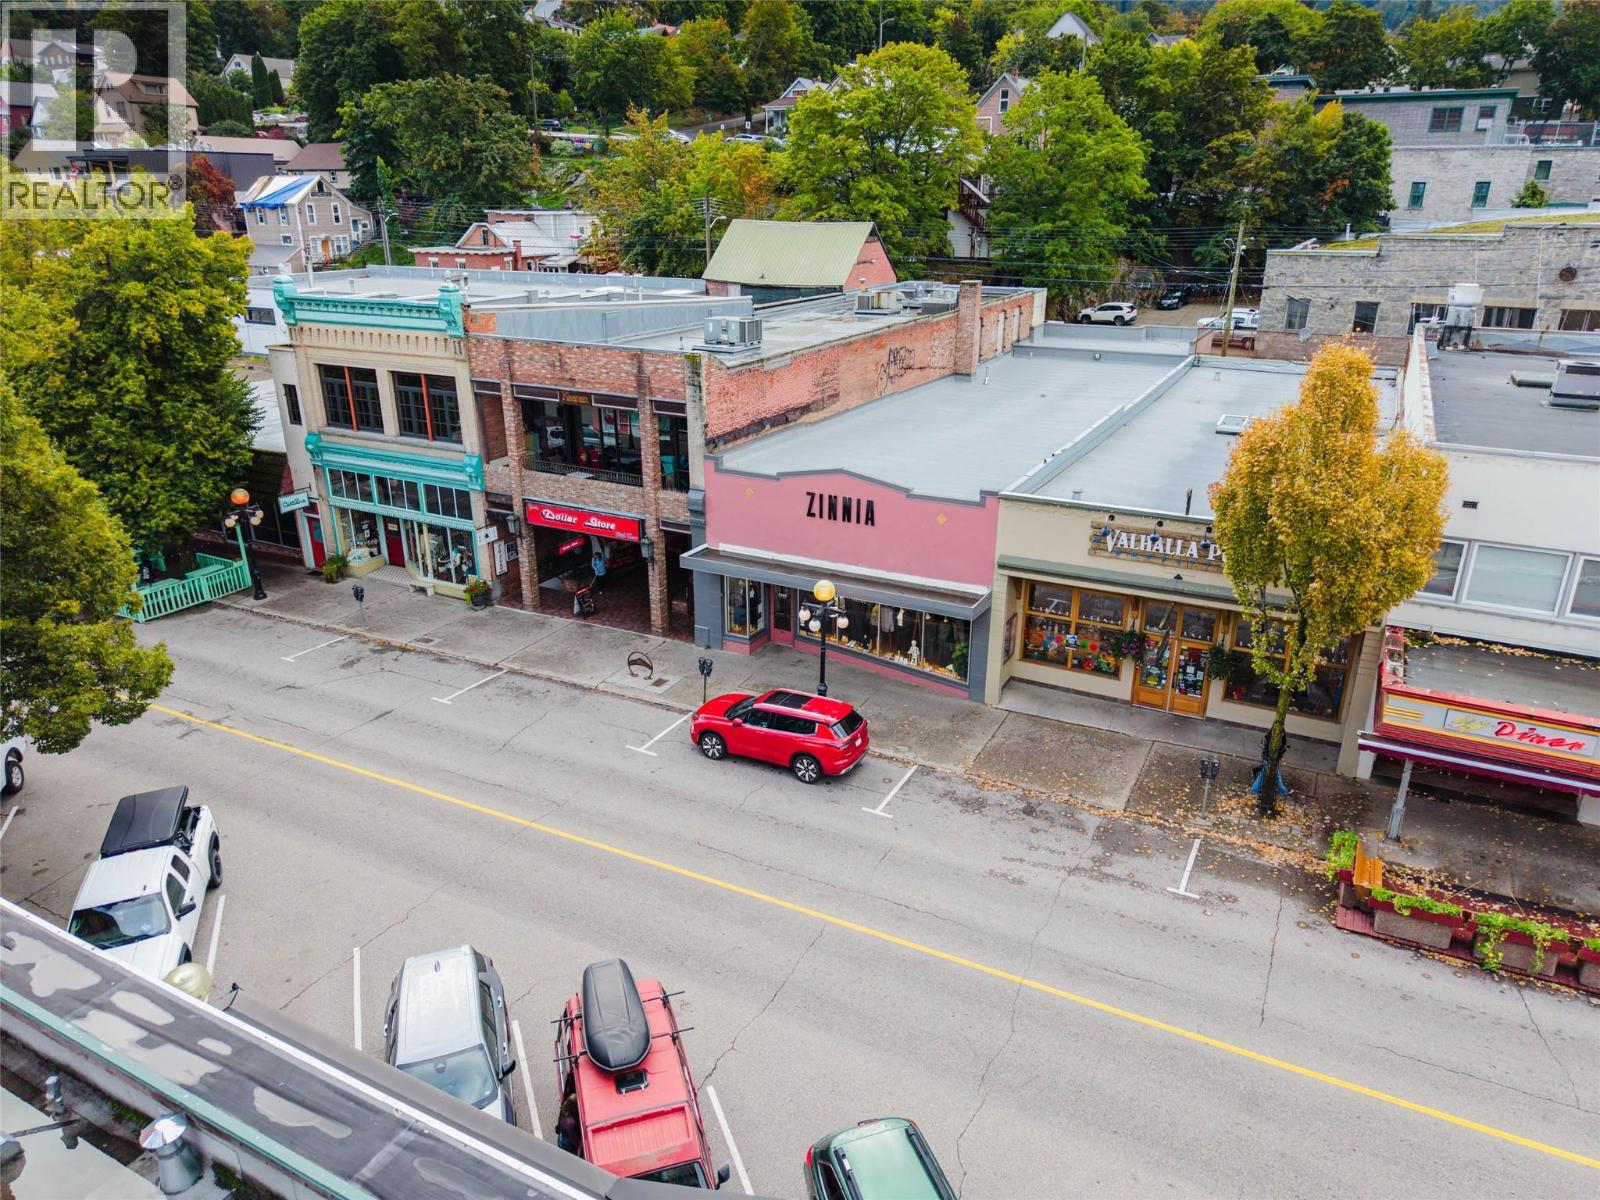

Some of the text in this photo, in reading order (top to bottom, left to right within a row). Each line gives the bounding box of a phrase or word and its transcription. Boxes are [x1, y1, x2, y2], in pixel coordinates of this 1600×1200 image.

[542, 509, 617, 532] Dollar Store
[806, 491, 875, 527] ZINNIA
[1105, 529, 1199, 559] VALHALLA
[1494, 721, 1587, 751] Diner
